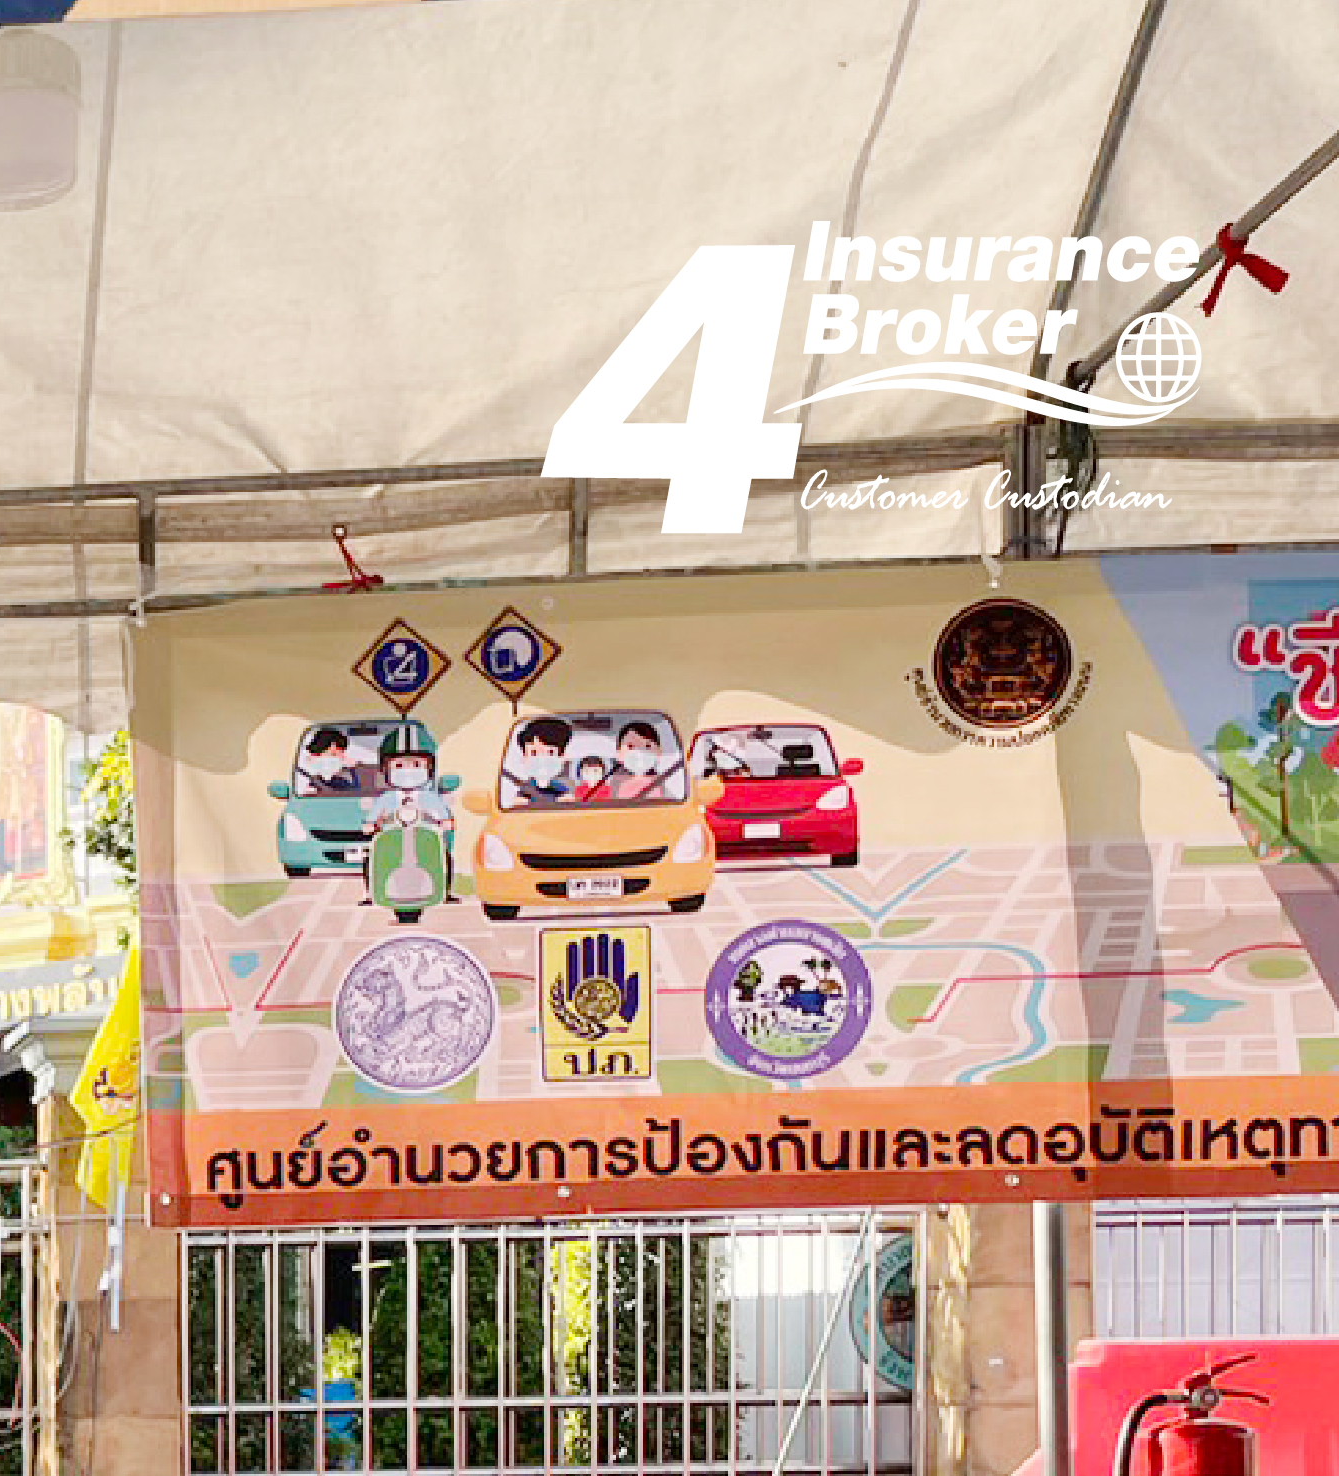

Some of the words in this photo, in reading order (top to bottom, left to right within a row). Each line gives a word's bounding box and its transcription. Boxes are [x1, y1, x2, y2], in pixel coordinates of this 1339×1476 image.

[206, 1106, 1339, 1208] ศูนย์อำนวยการป้องกันและลดอุบัติเหตุท
